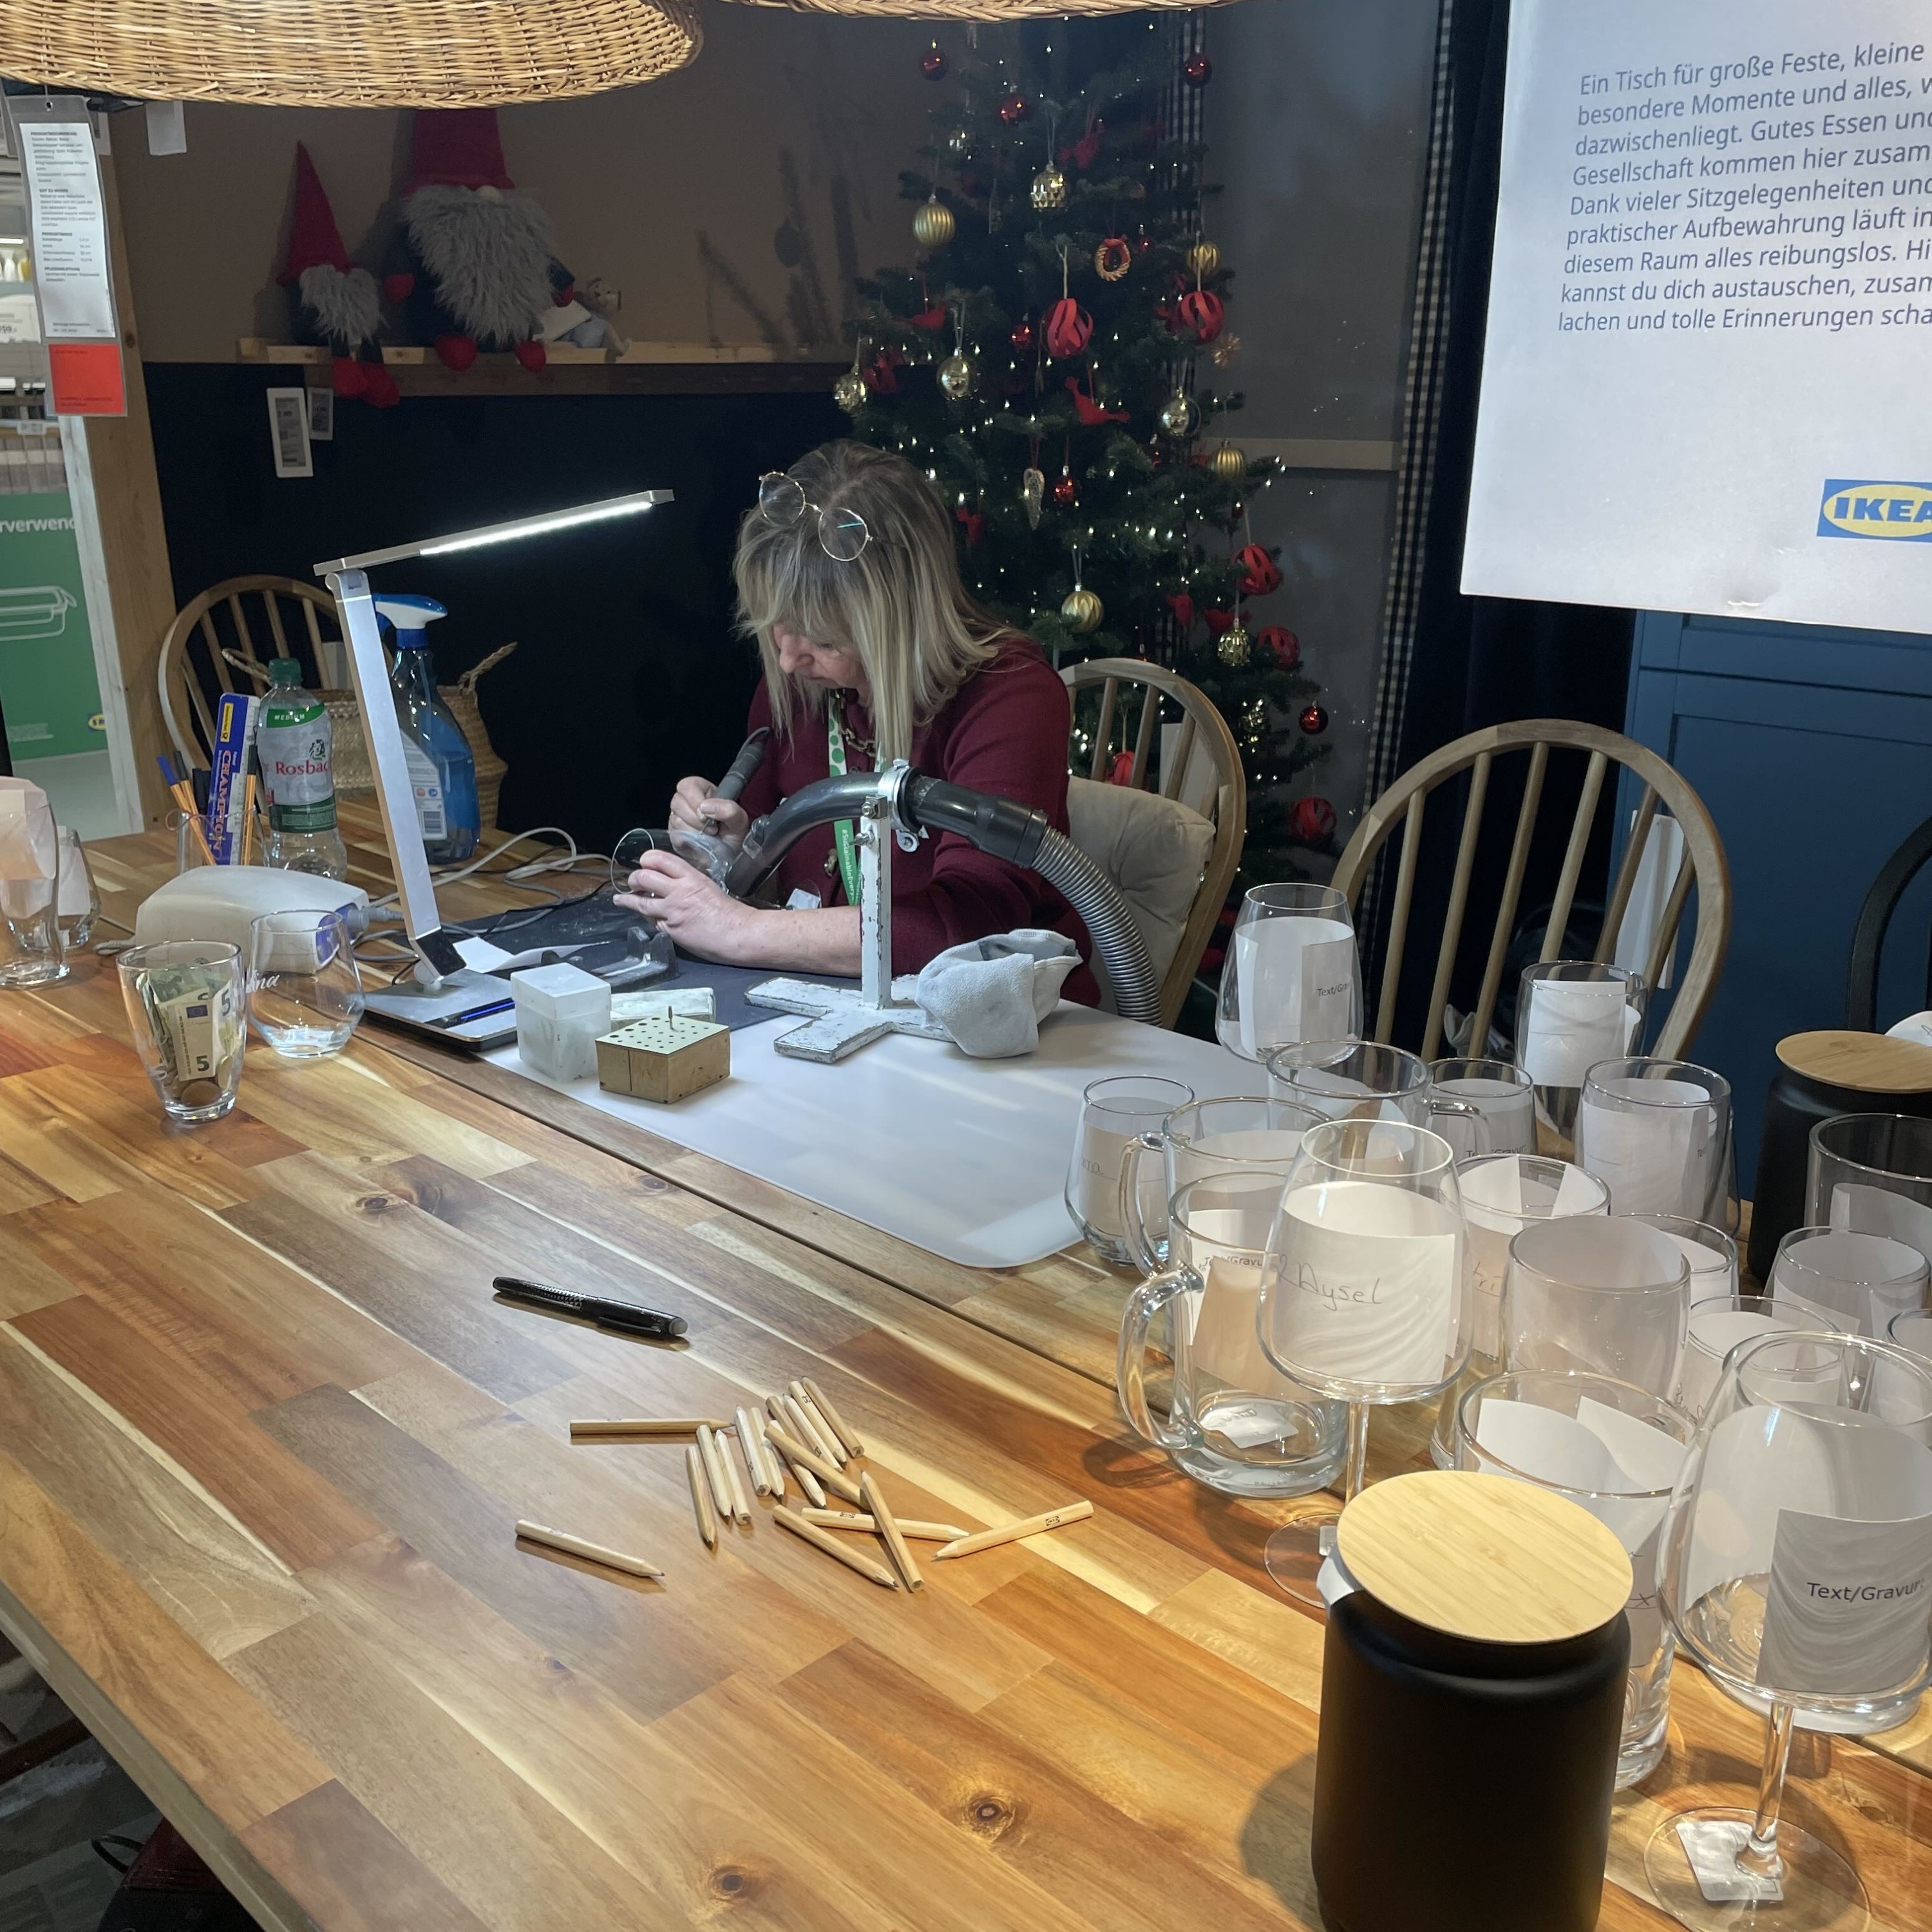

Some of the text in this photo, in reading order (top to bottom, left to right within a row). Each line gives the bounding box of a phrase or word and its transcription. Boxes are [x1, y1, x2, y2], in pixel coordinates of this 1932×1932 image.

[1580, 42, 1925, 95] Ein Tisch für große Feste, kleine
[1578, 98, 1685, 126] besondere
[1692, 88, 1795, 115] Momente
[1803, 79, 1847, 105] und
[1853, 75, 1912, 100] alles,
[1575, 124, 1743, 156] dazwischenliegt.
[1751, 120, 1815, 142] Gutes
[1822, 114, 1887, 136] Essen
[1573, 144, 1931, 185] Gesellschaft kommen hier zusam
[1570, 193, 1620, 216] Dank
[1625, 189, 1682, 212] vieler
[1686, 178, 1884, 213] Sitzgelegenheiten
[1566, 220, 1679, 251] praktischer
[1681, 213, 1846, 240] Aufbewahrung
[1852, 206, 1907, 231] läuft
[1564, 254, 1634, 274] diesem
[1640, 251, 1698, 271] Raum
[1705, 247, 1753, 269] alles
[1759, 242, 1897, 270] reibungslos.
[1561, 283, 1627, 303] kannst
[1631, 280, 1657, 301] du
[1663, 278, 1705, 300] dich
[1712, 274, 1855, 299] austauschen,
[1558, 311, 1620, 331] lachen
[1627, 309, 1666, 330] und
[1672, 308, 1716, 329] tolle
[1722, 308, 1873, 332] Erinnerungen
[196, 1055, 210, 1072] 5
